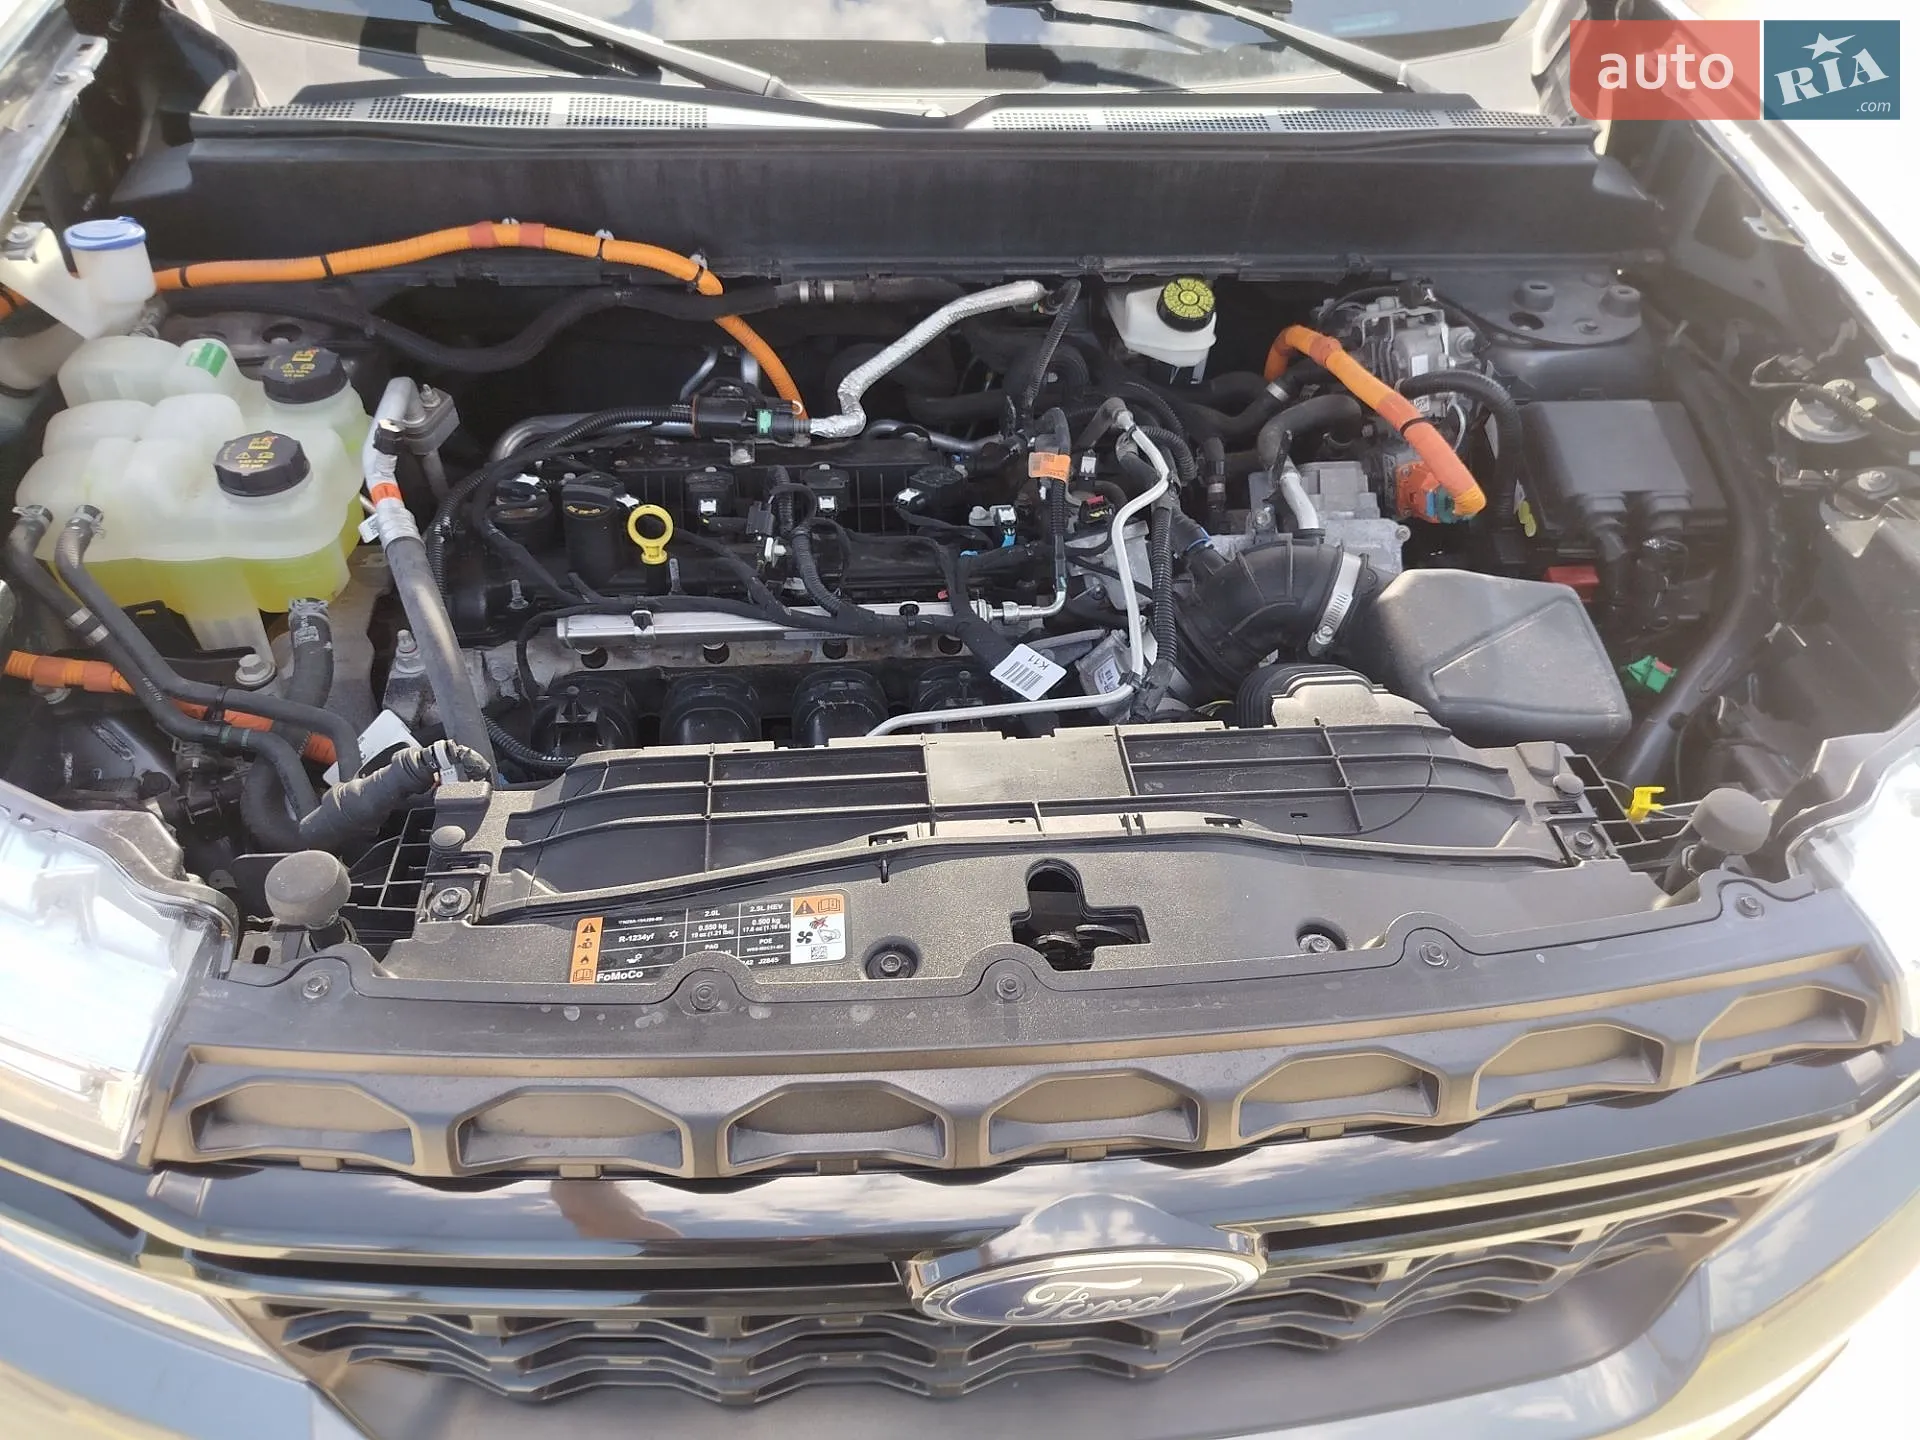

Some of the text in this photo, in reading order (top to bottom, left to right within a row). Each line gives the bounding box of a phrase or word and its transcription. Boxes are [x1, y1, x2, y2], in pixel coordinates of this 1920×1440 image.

[618, 933, 655, 943] R-1234yf
[596, 970, 644, 982] FoMoCo
[1005, 1276, 1184, 1320] Ford
